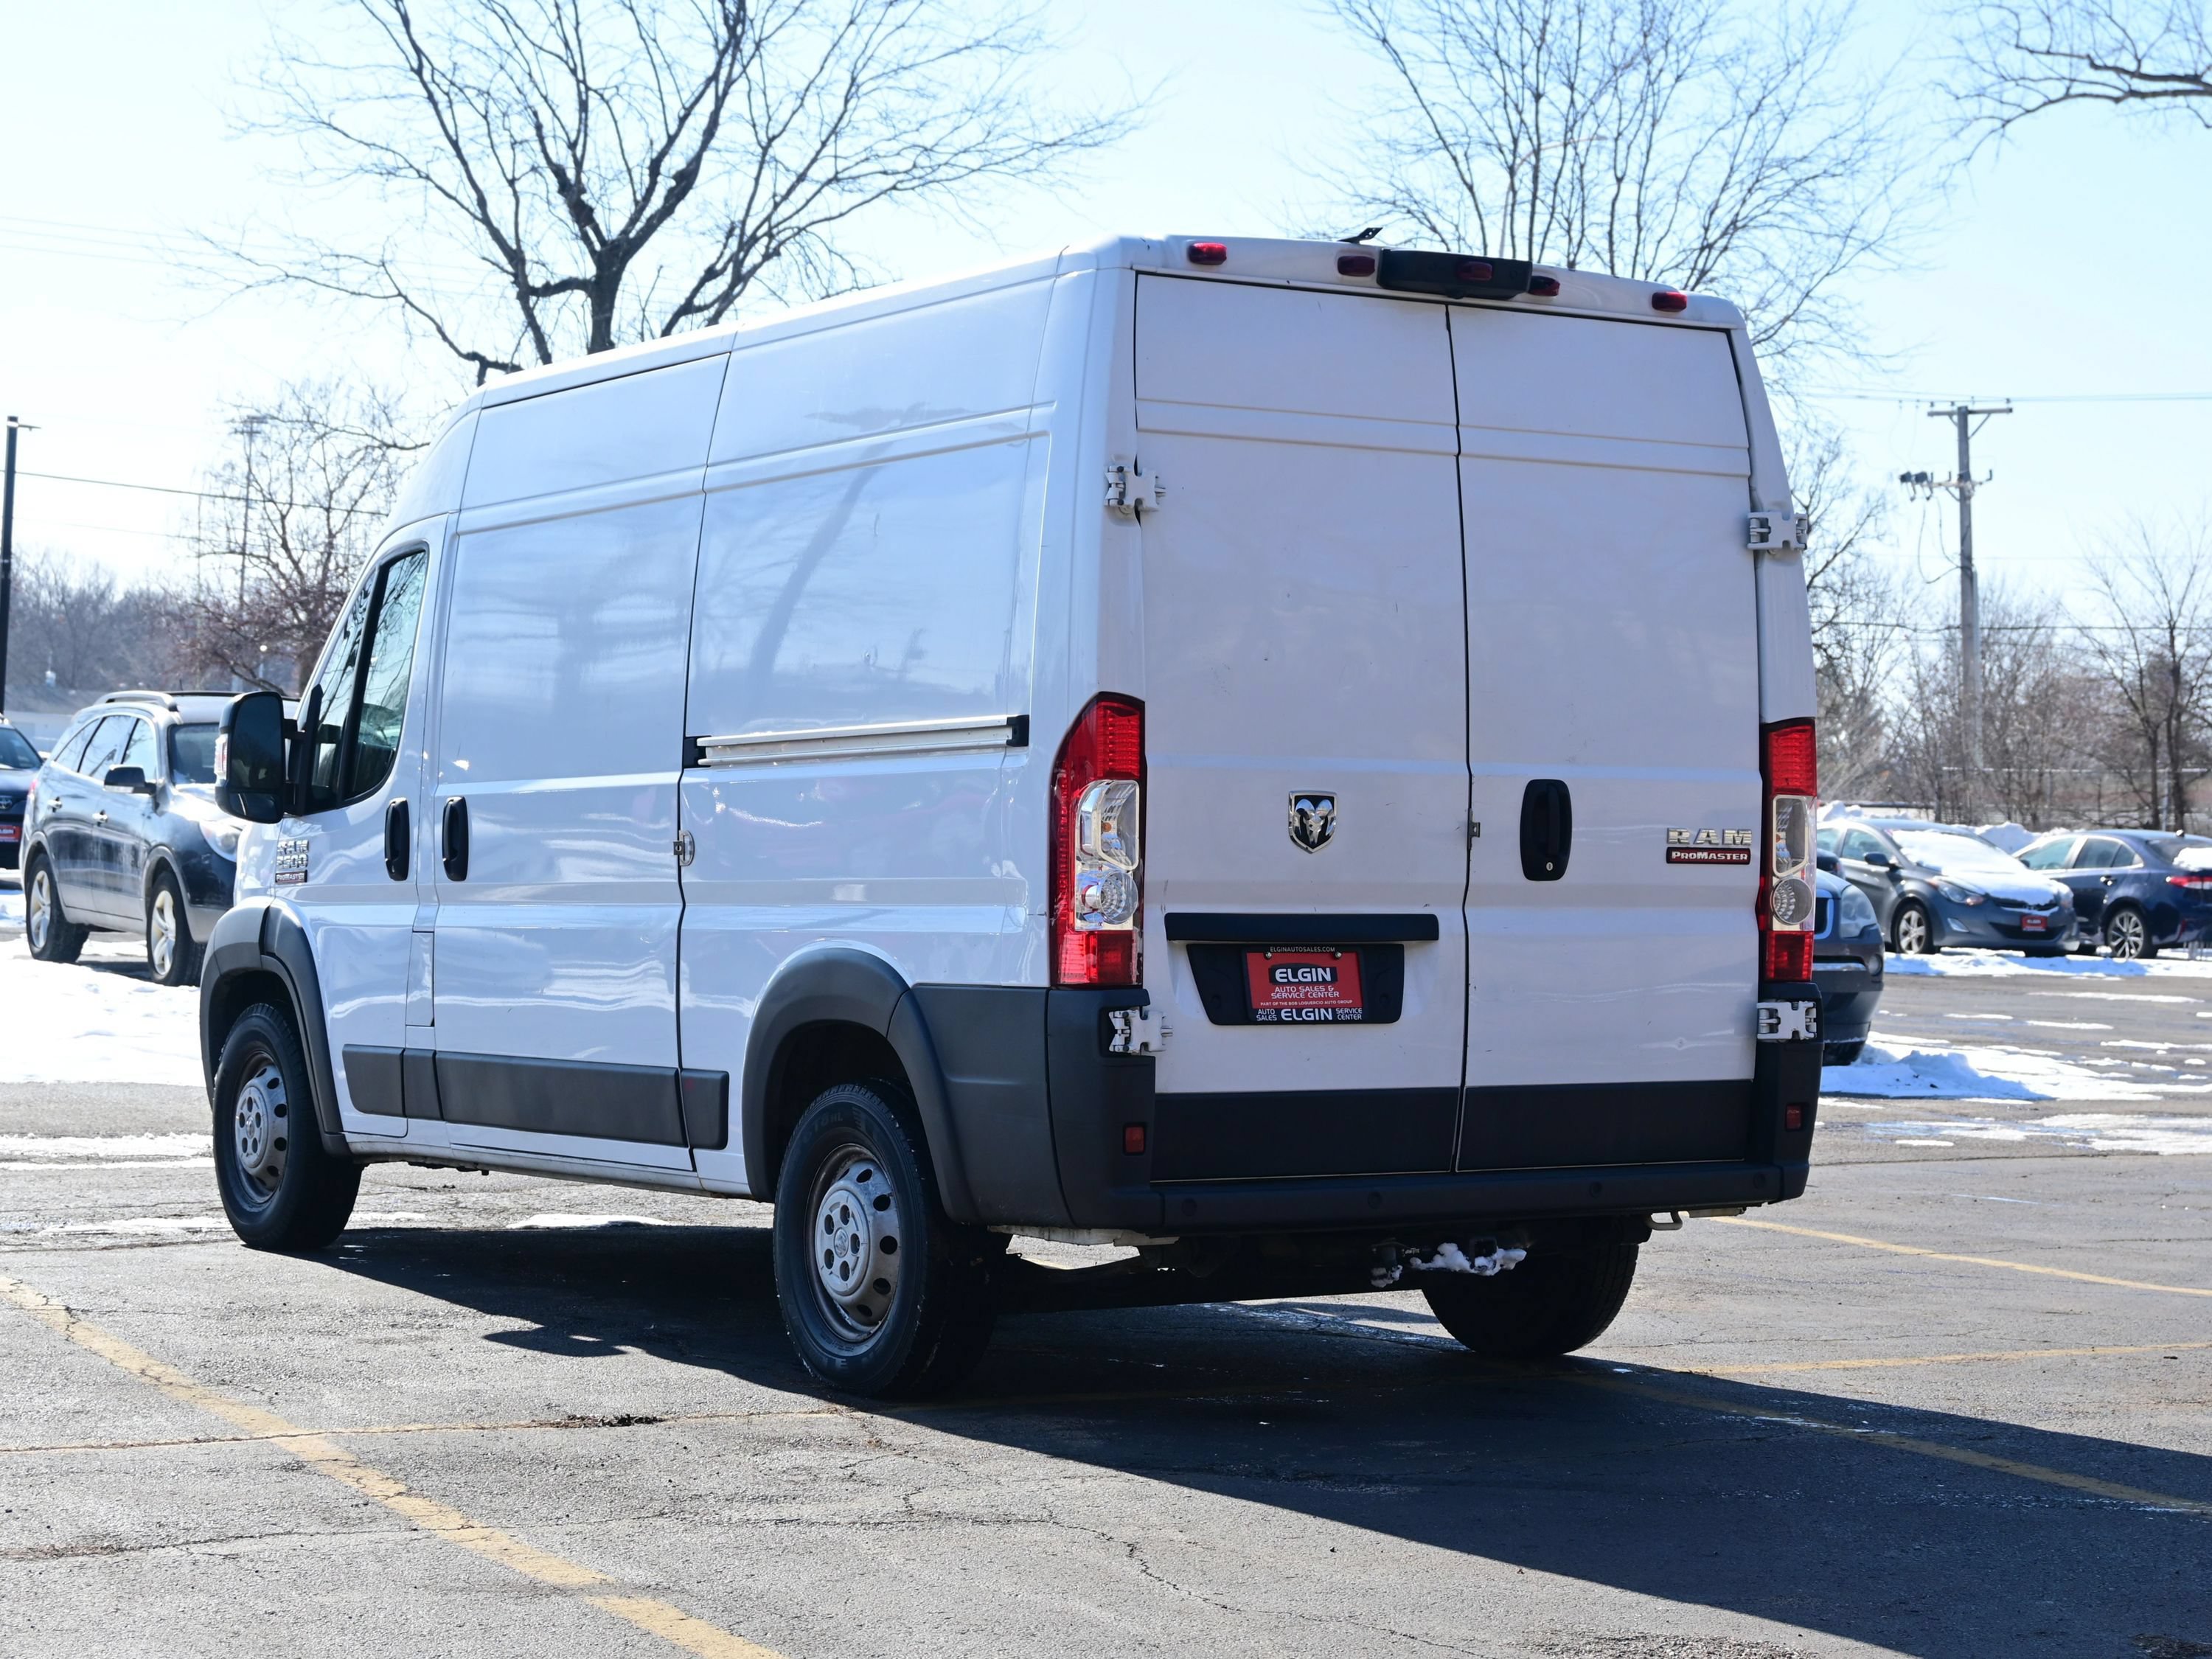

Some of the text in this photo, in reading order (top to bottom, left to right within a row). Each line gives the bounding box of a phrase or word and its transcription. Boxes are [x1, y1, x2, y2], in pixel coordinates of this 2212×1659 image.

[1666, 828, 1753, 846] RAM
[1275, 967, 1332, 982] ELGIN
[1281, 1009, 1332, 1021] ELGIN
